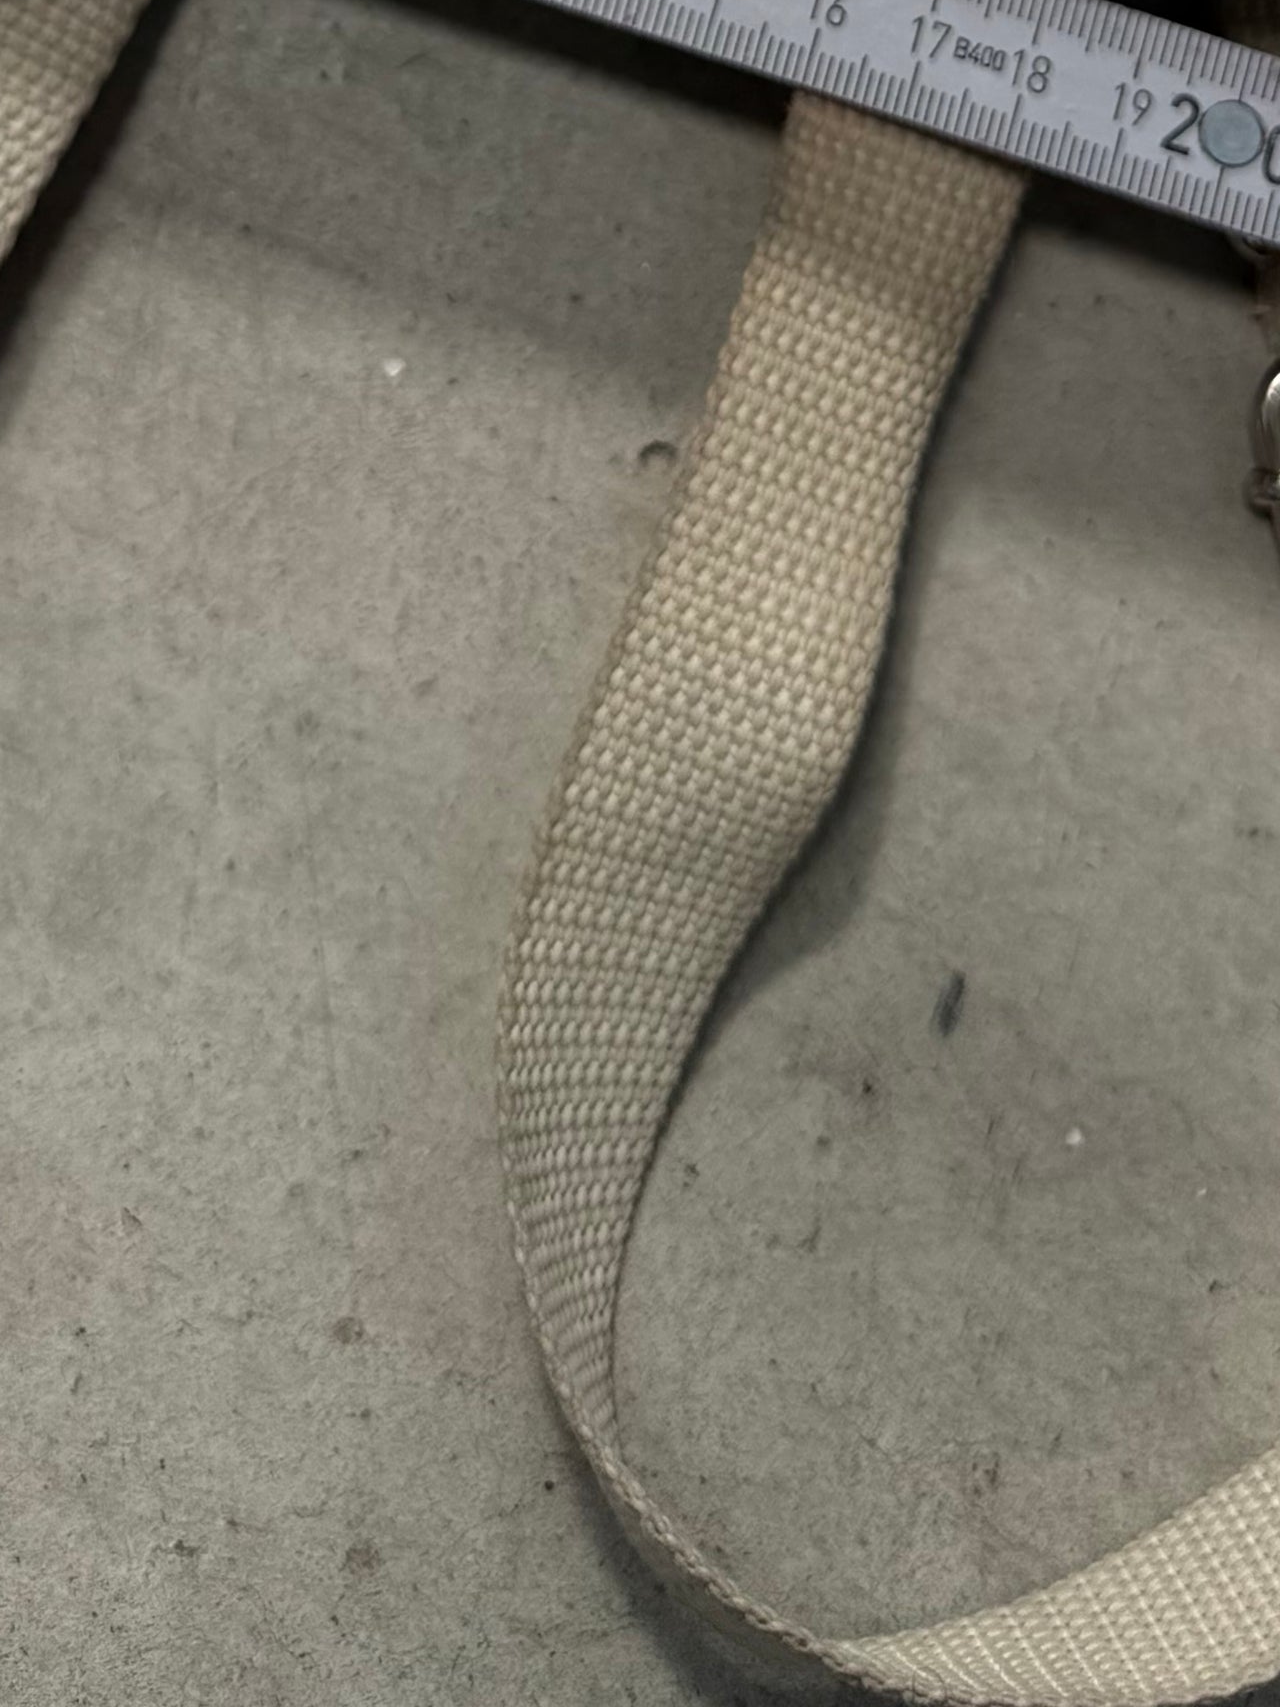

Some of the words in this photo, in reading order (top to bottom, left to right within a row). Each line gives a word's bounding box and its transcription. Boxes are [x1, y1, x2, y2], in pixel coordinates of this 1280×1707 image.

[911, 15, 953, 60] 17
[952, 36, 1007, 72] B400
[1012, 48, 1053, 94] 18
[1114, 83, 1153, 126] 19
